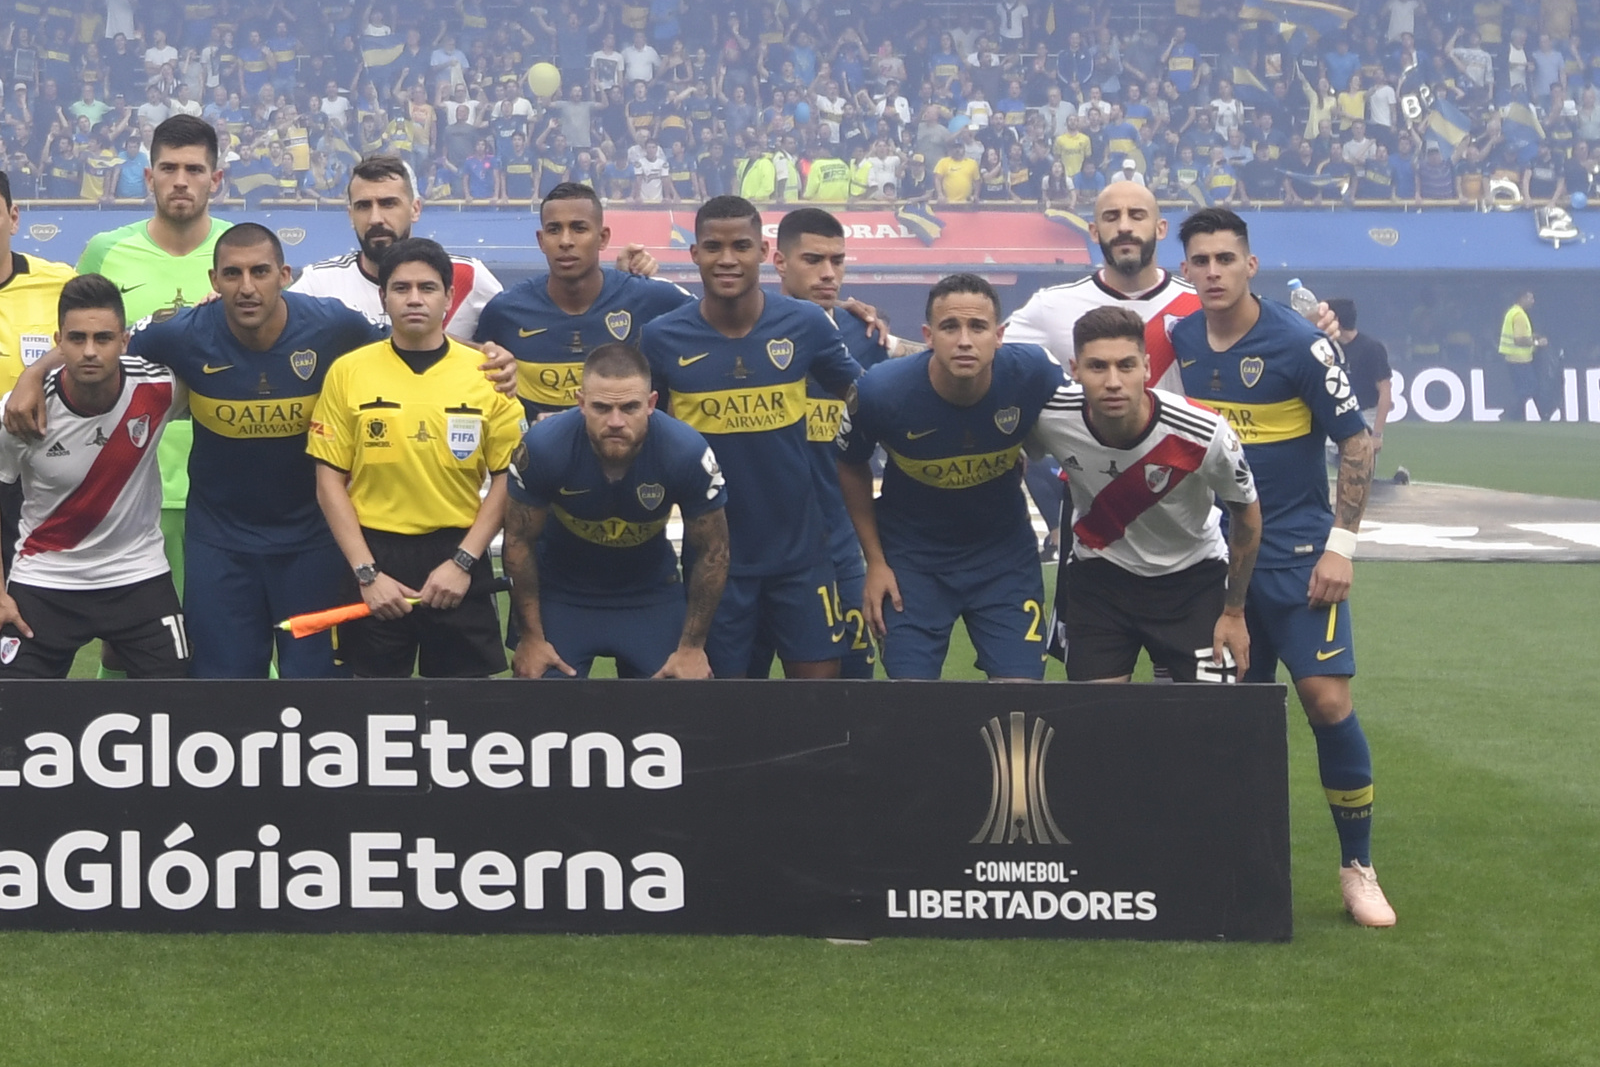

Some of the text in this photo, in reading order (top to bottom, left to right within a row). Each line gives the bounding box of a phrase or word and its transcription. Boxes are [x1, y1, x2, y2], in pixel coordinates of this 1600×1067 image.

[216, 402, 304, 426] QATAR
[701, 391, 785, 420] QATAR
[238, 421, 304, 435] AIRWAYS
[725, 410, 786, 429] AIRWAYS
[450, 433, 475, 443] FIFA
[922, 454, 1008, 479] QATAR
[887, 888, 1157, 922] LIBERTADORES
